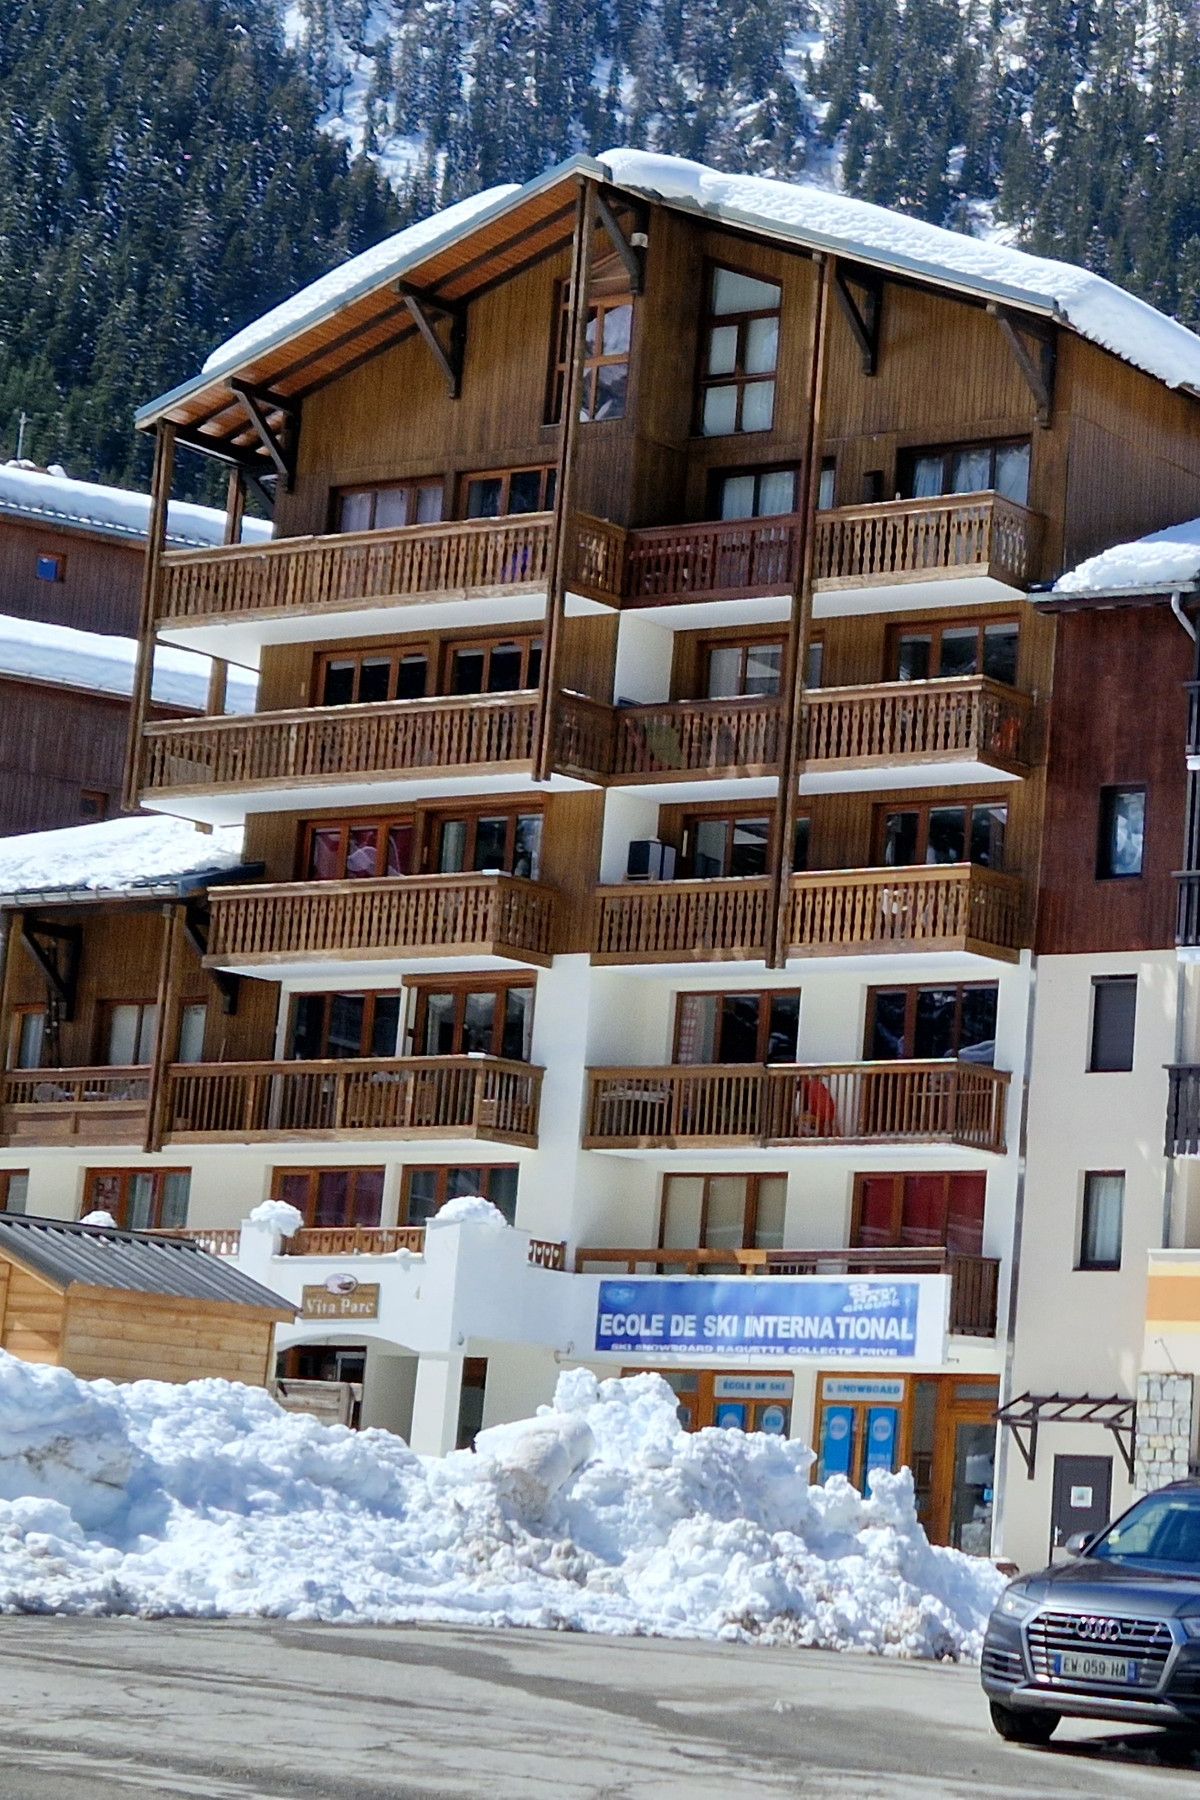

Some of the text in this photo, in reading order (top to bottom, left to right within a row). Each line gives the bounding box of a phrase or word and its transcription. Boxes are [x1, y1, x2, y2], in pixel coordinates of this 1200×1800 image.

[341, 1299, 374, 1313] Parc
[600, 1314, 914, 1341] ECOLE DE SKI INTERNATIONAL
[635, 1344, 713, 1353] SNOWBOARD
[716, 1345, 785, 1354] RAQUETTE
[787, 1346, 856, 1355] COLLECTIF
[755, 1382, 766, 1390] DE
[770, 1382, 785, 1391] SKI
[837, 1384, 900, 1394] SNOWBOARD
[1083, 1659, 1106, 1676] 059
[1111, 1661, 1126, 1677] HA
